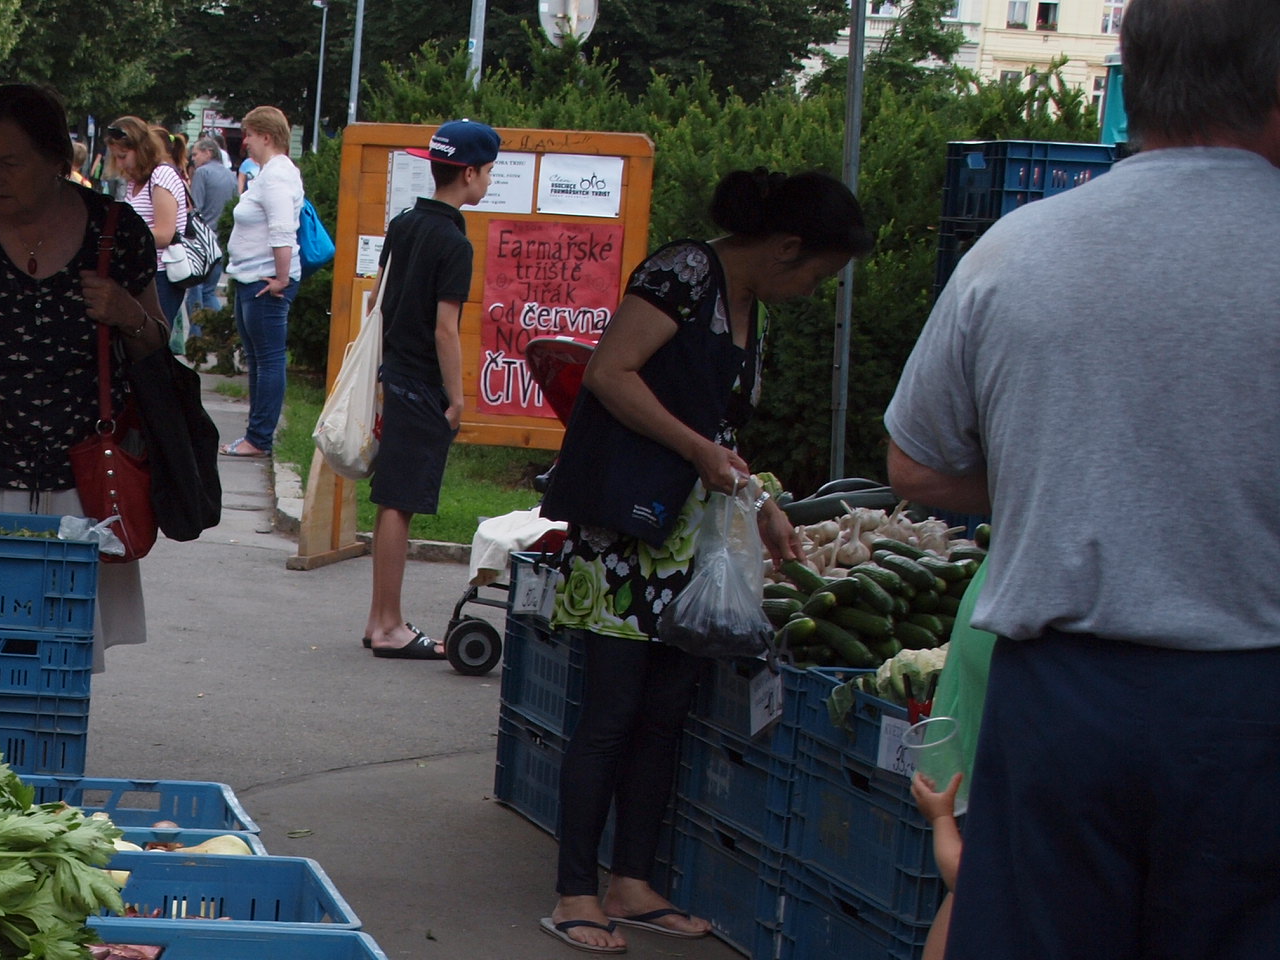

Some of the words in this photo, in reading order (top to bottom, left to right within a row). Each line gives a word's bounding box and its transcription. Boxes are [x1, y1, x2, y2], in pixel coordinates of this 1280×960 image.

[497, 229, 614, 262] Farmářské
[515, 257, 584, 282] tržiště
[518, 281, 577, 304] Jiřák
[520, 302, 611, 334] června
